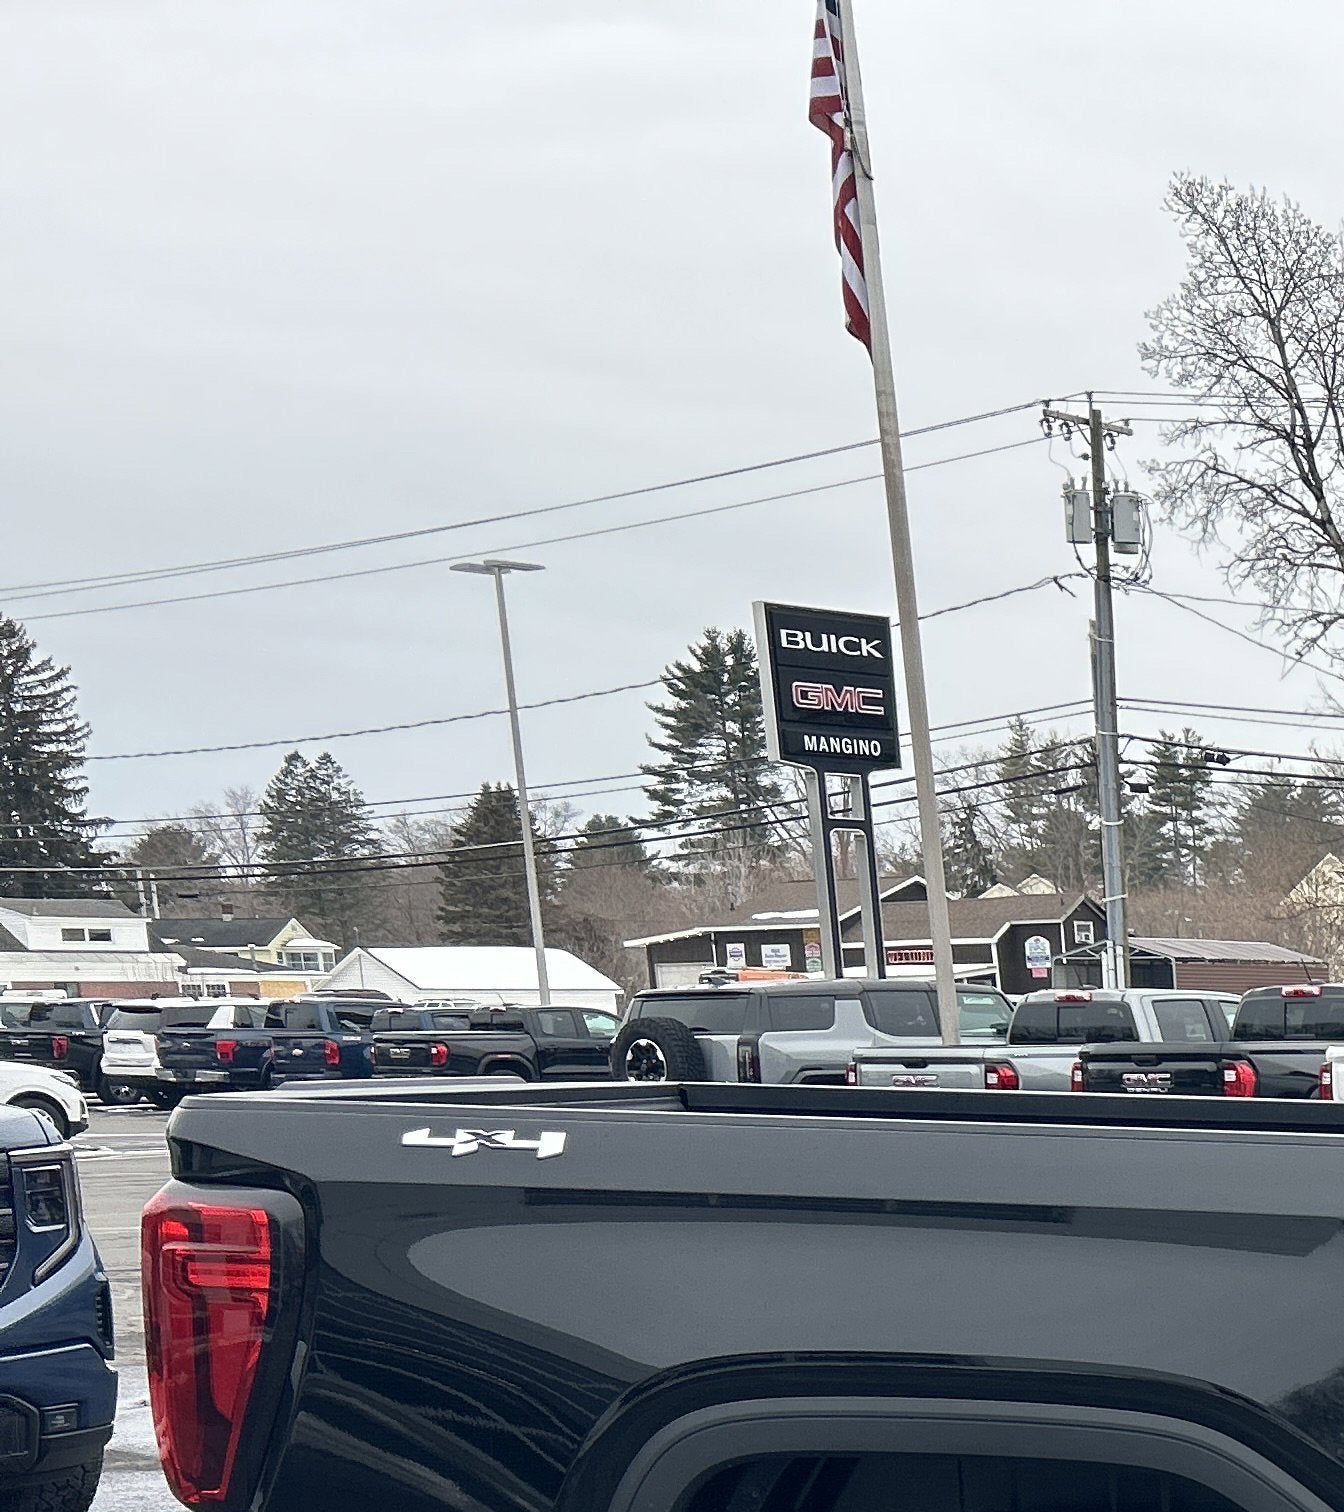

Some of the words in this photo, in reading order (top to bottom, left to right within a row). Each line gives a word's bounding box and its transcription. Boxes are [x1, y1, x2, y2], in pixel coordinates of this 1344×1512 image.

[779, 628, 885, 659] BUICK
[791, 681, 885, 716] GMC
[803, 735, 881, 757] MANGINO
